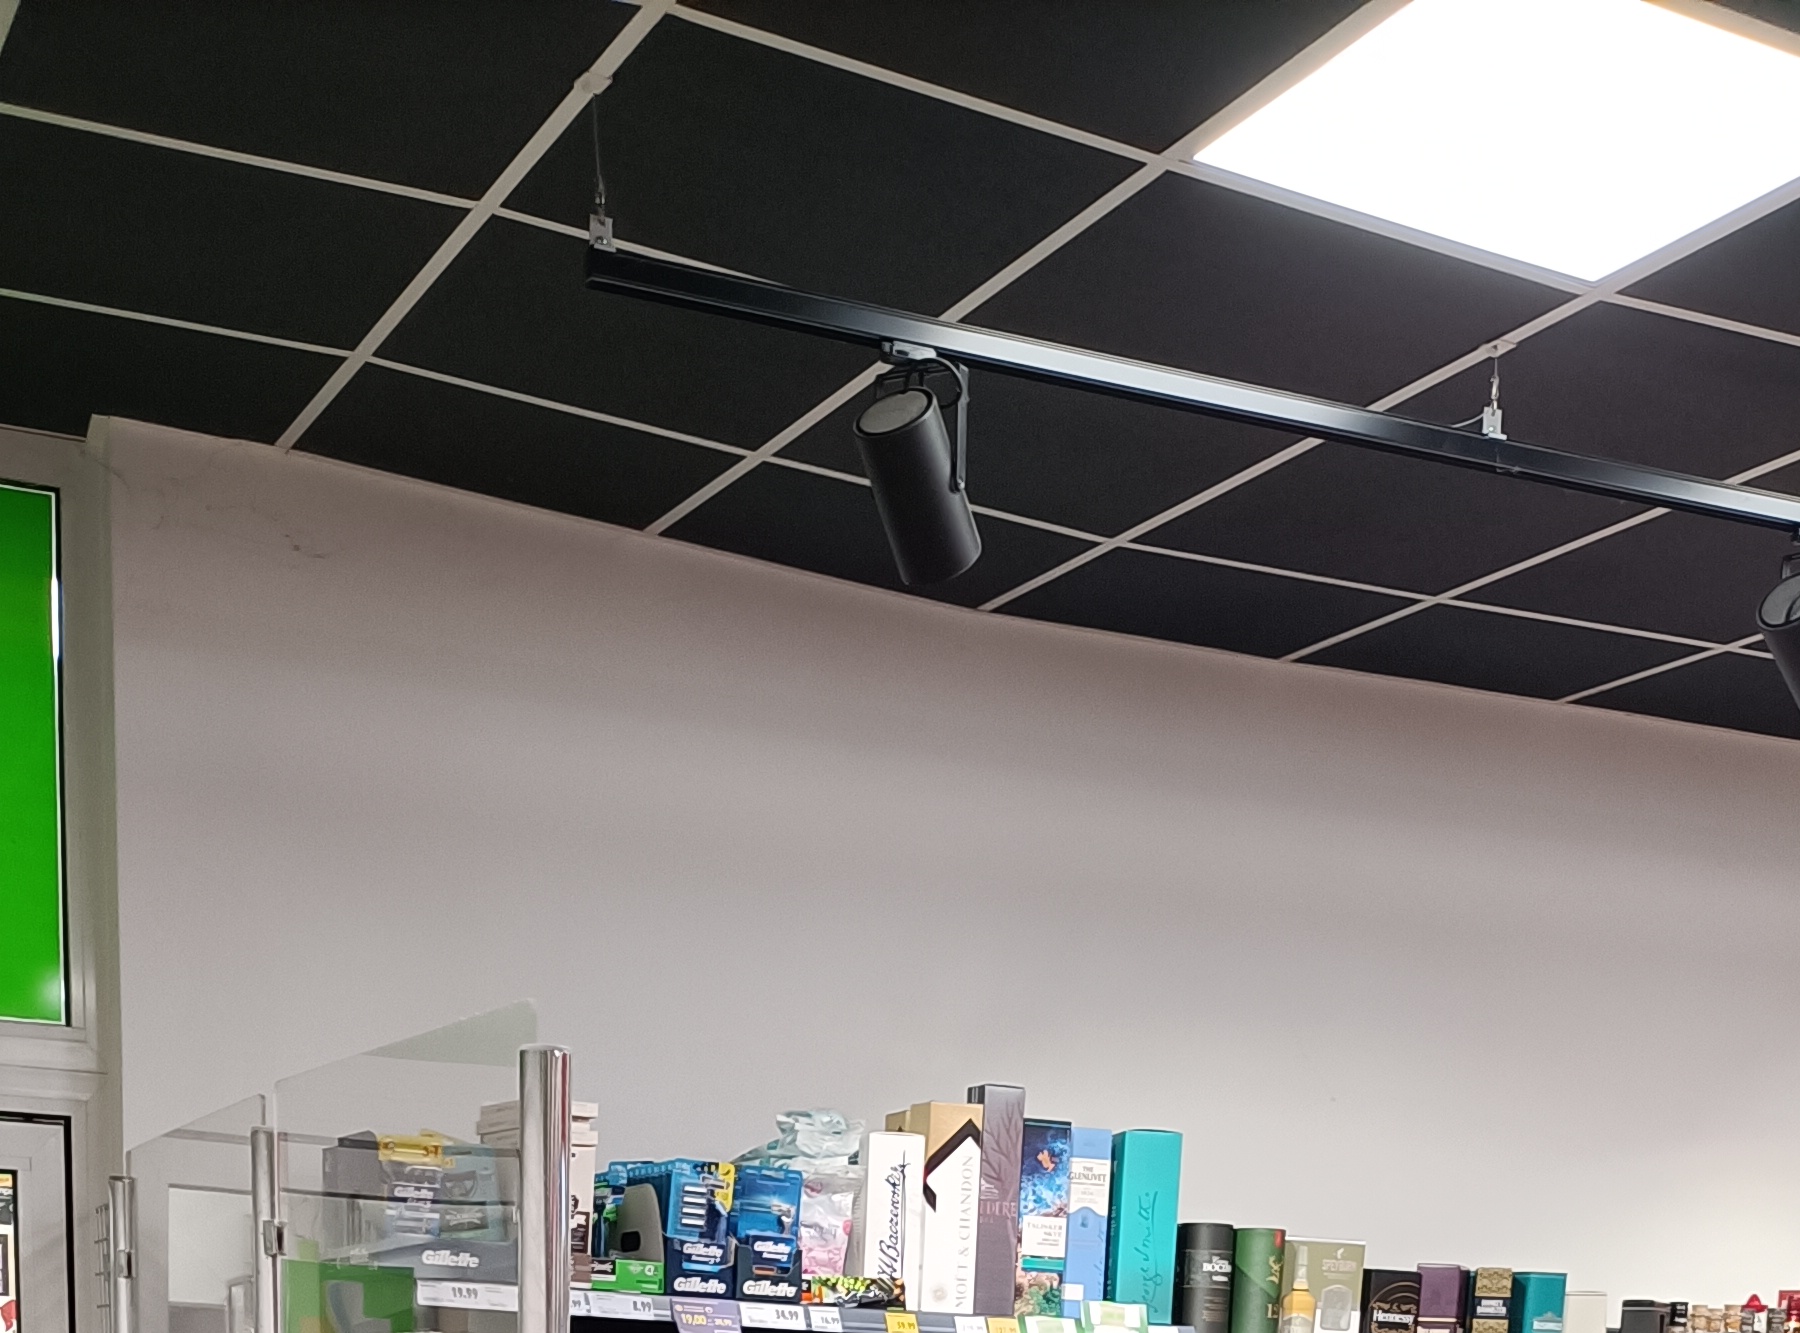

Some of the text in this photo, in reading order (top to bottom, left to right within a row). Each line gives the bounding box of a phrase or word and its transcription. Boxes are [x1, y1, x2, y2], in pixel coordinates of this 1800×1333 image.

[1069, 1172, 1107, 1183] GLENLIVET
[421, 1250, 480, 1268] Gillette
[682, 1243, 723, 1258] Gillette
[673, 1277, 727, 1294] Gillette
[742, 1280, 798, 1298] Gillette
